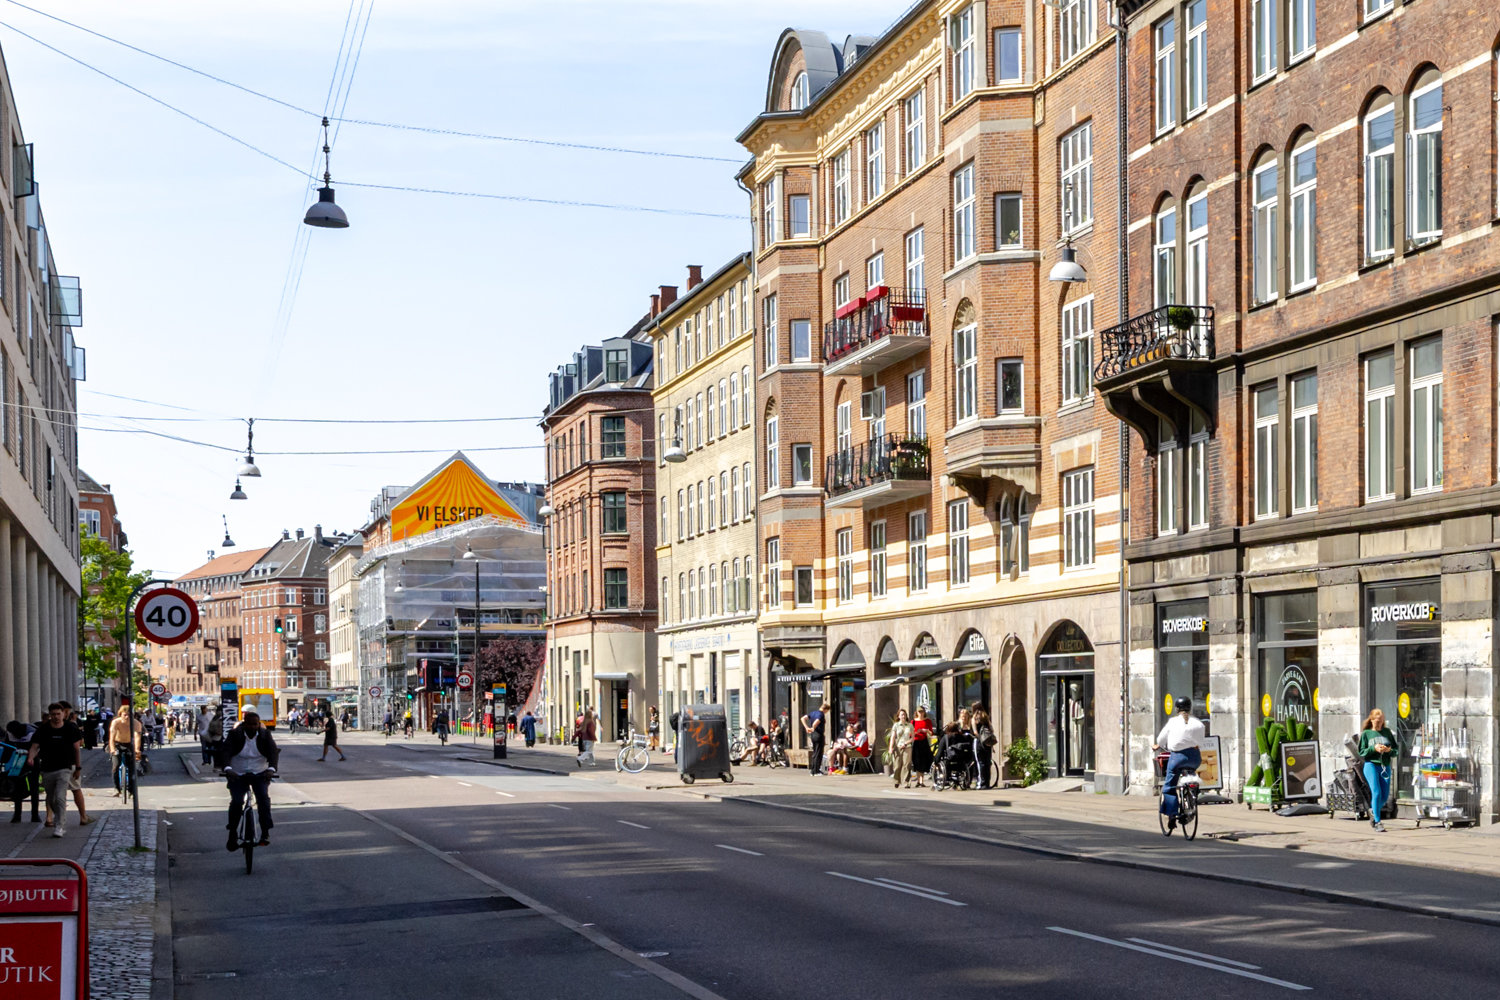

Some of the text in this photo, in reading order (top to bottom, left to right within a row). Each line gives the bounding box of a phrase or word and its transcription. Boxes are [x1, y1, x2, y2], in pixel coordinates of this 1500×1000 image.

[417, 506, 429, 521] VI
[145, 605, 187, 627] 40
[969, 633, 985, 652] Elita
[1277, 704, 1310, 722] HAFNIA
[0, 888, 68, 904] ØJBUTIK
